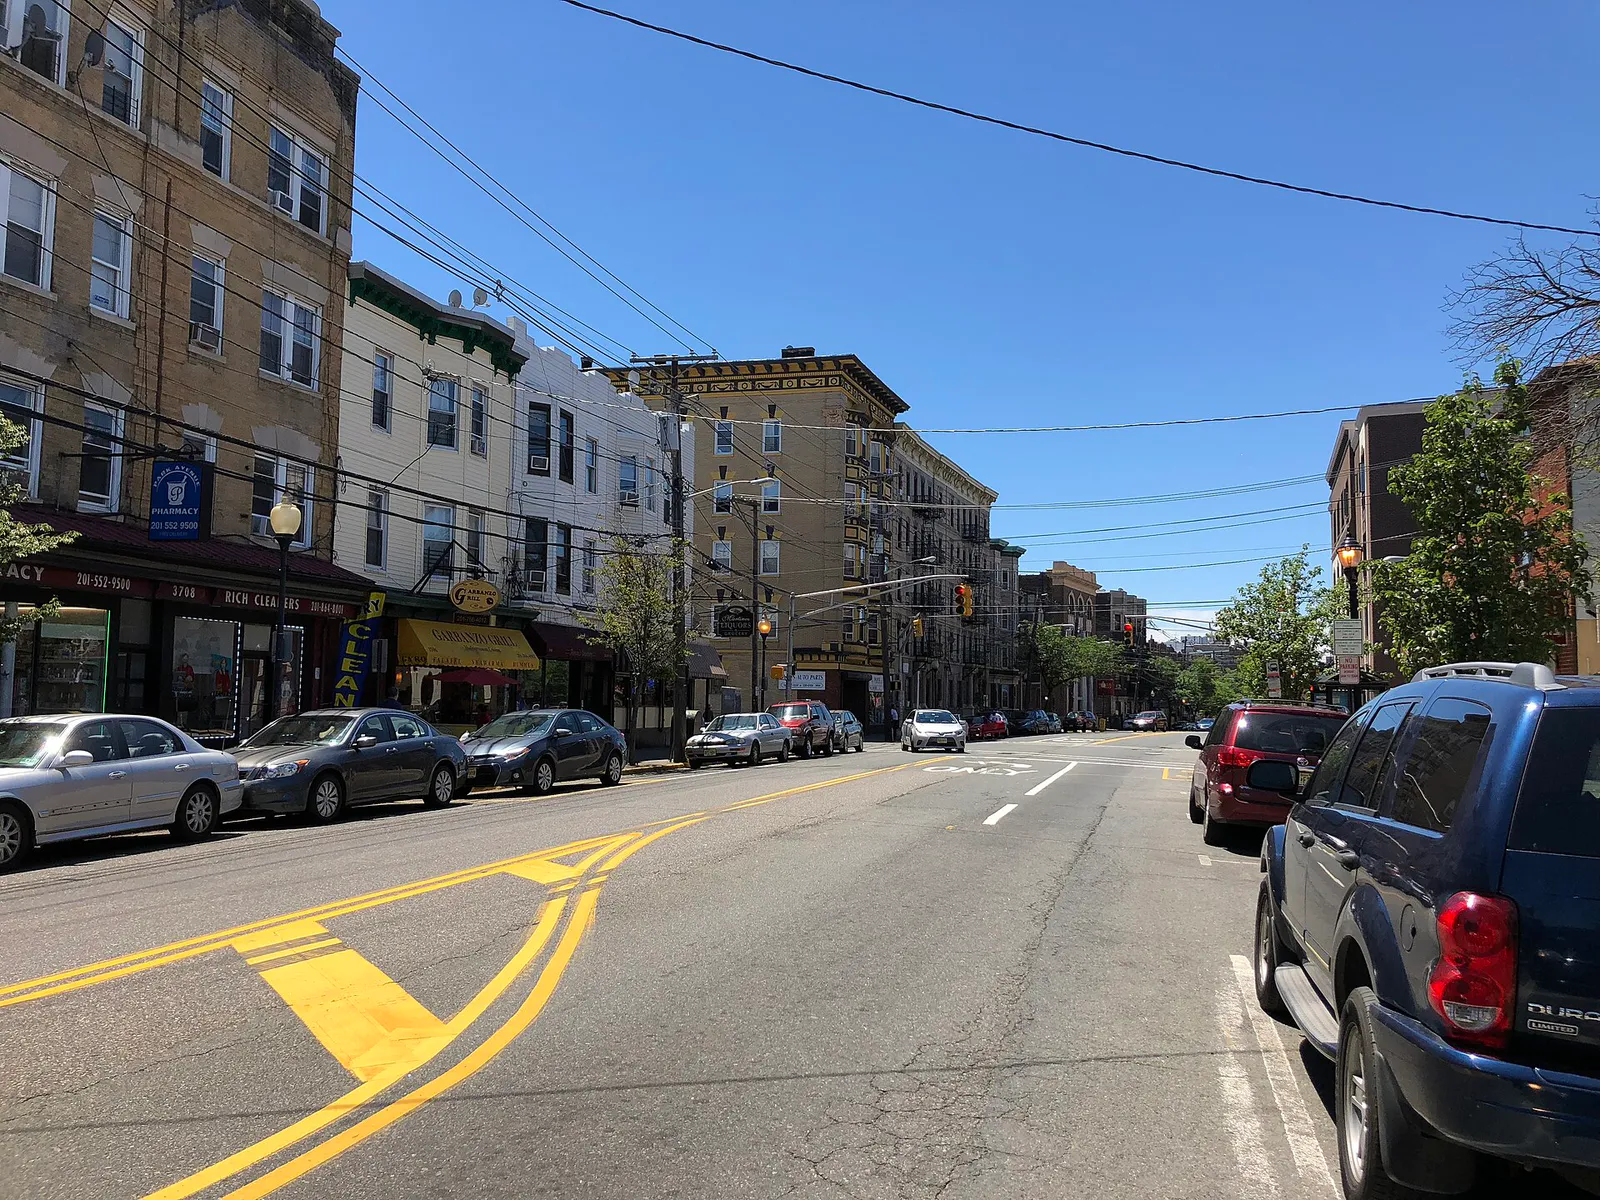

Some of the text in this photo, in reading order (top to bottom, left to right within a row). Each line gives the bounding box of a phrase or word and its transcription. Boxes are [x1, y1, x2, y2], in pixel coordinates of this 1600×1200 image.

[153, 465, 200, 488] PARK AVENUE
[151, 507, 199, 515] PHARMACY
[0, 562, 45, 581] ACY
[77, 572, 131, 591] 201-552-9500
[172, 585, 196, 599] 3708
[225, 590, 249, 605] RICH
[720, 621, 752, 630] LIQUORS
[431, 628, 518, 647] GARBANZO GRILL
[334, 623, 371, 707] CLEAN
[1531, 1022, 1575, 1033] LIMITED
